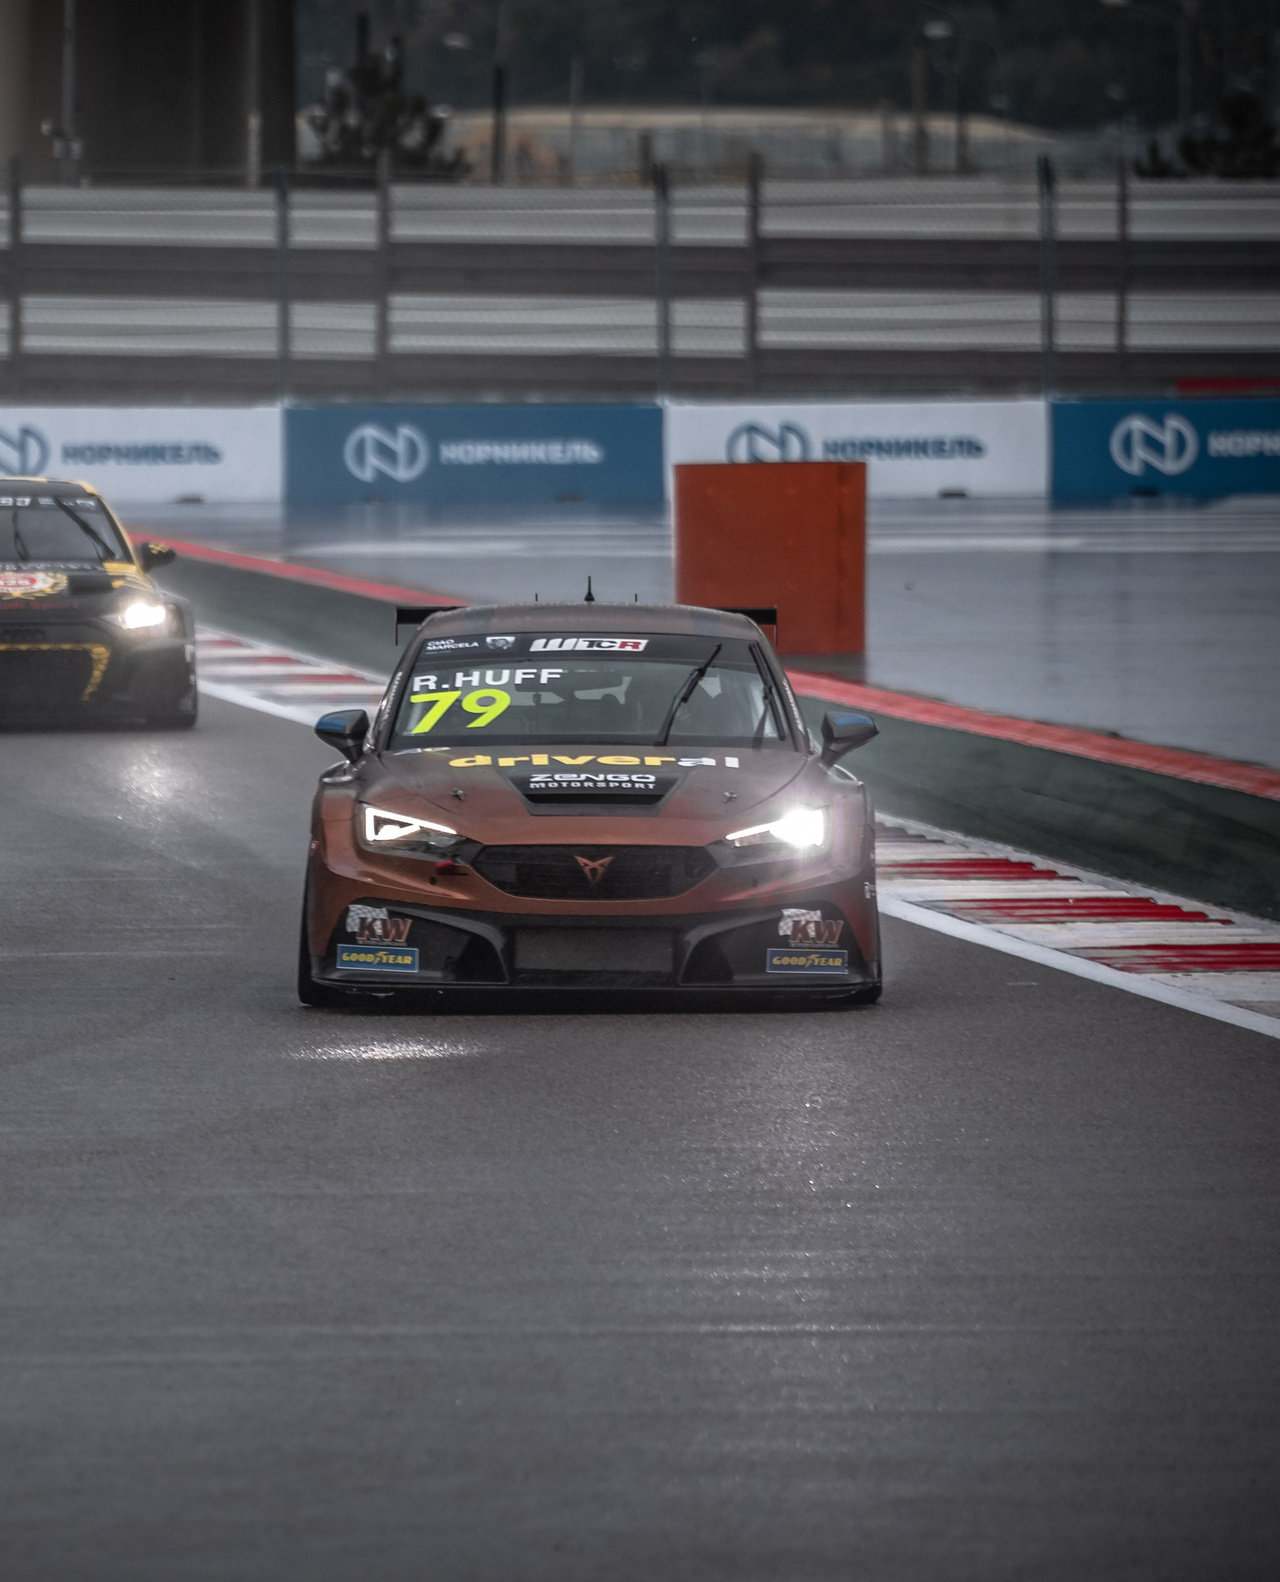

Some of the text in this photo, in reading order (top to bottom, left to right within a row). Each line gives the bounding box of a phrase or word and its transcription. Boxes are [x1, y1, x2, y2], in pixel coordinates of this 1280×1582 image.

[60, 443, 223, 465] НОРНИКЕЛЬ
[439, 442, 602, 465] НОРНИКЕЛЬ
[822, 437, 986, 460] НОРНИКЕЛЬ
[409, 688, 511, 735] 79
[529, 781, 656, 790] MOTORSPORT
[356, 917, 413, 942] KW
[789, 919, 844, 944] KW
